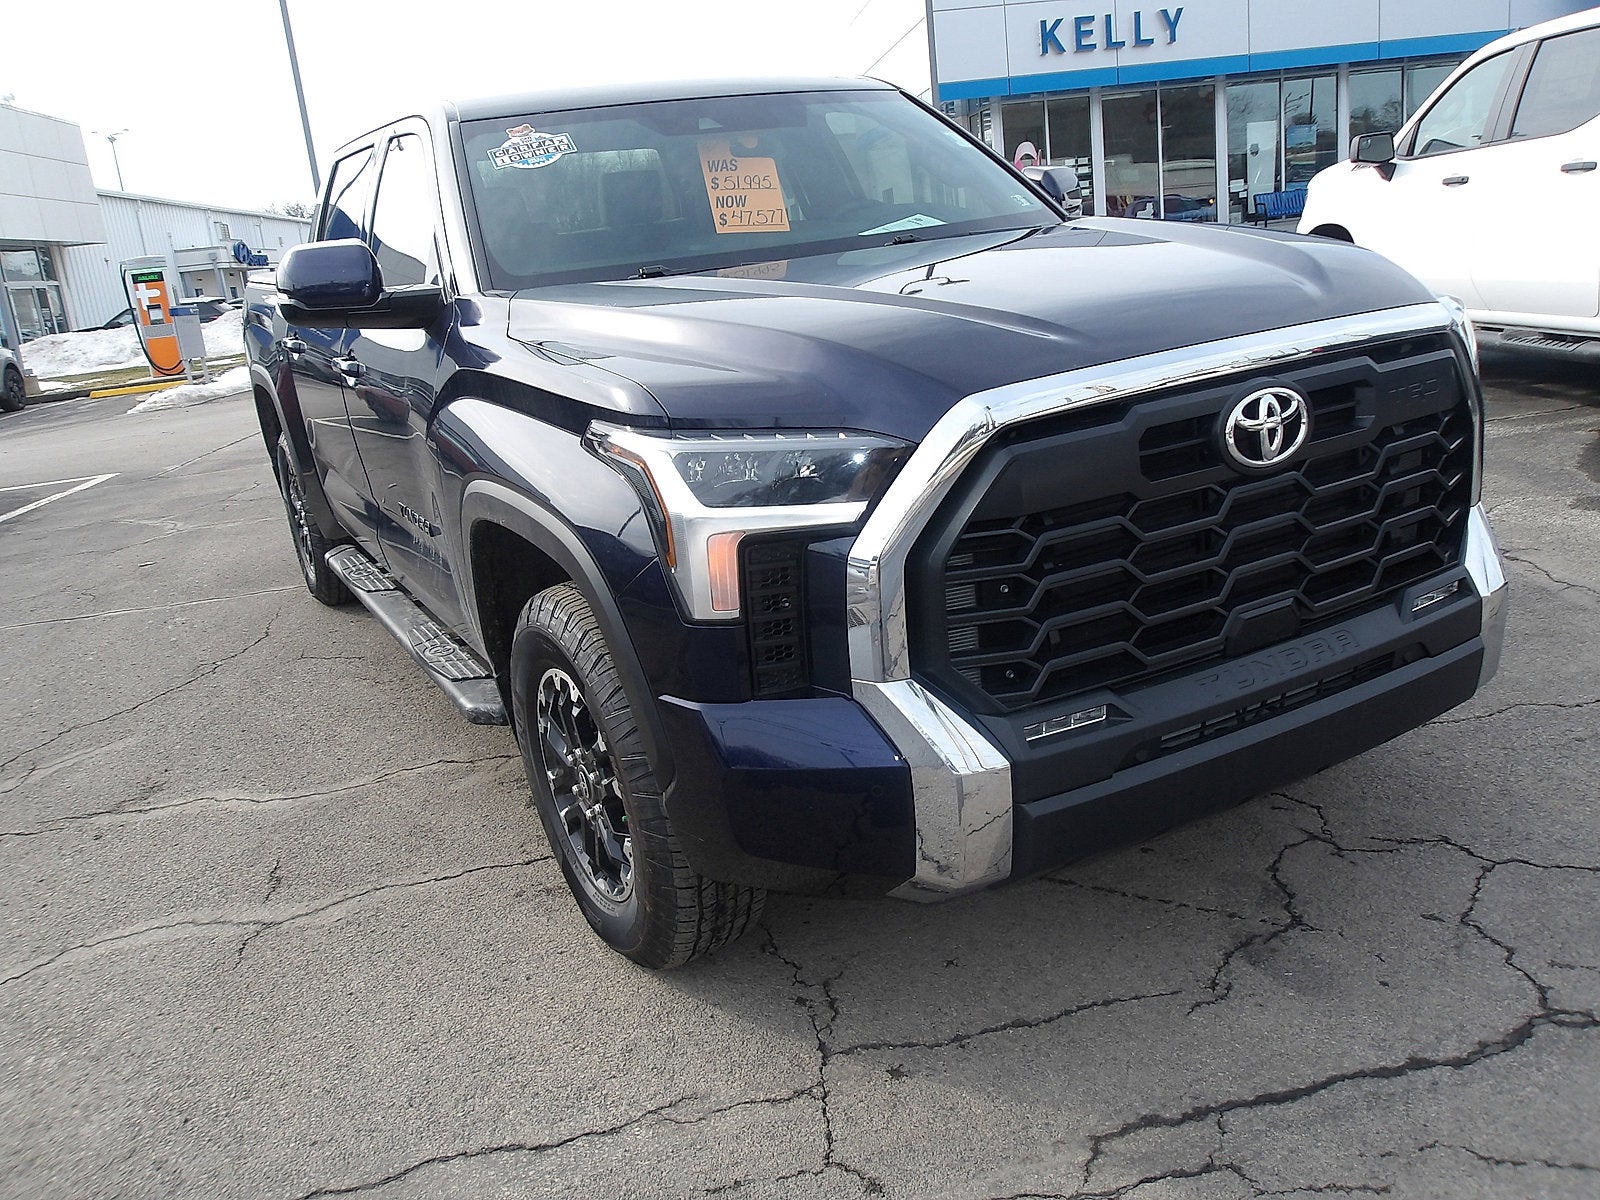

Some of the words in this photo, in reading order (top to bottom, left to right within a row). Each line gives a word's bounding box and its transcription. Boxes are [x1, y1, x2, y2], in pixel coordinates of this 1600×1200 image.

[1039, 6, 1185, 57] KELLY
[494, 138, 567, 158] CARFAX
[707, 159, 738, 173] WAS
[715, 195, 747, 209] NOW
[1196, 628, 1361, 698] TUNDRA
